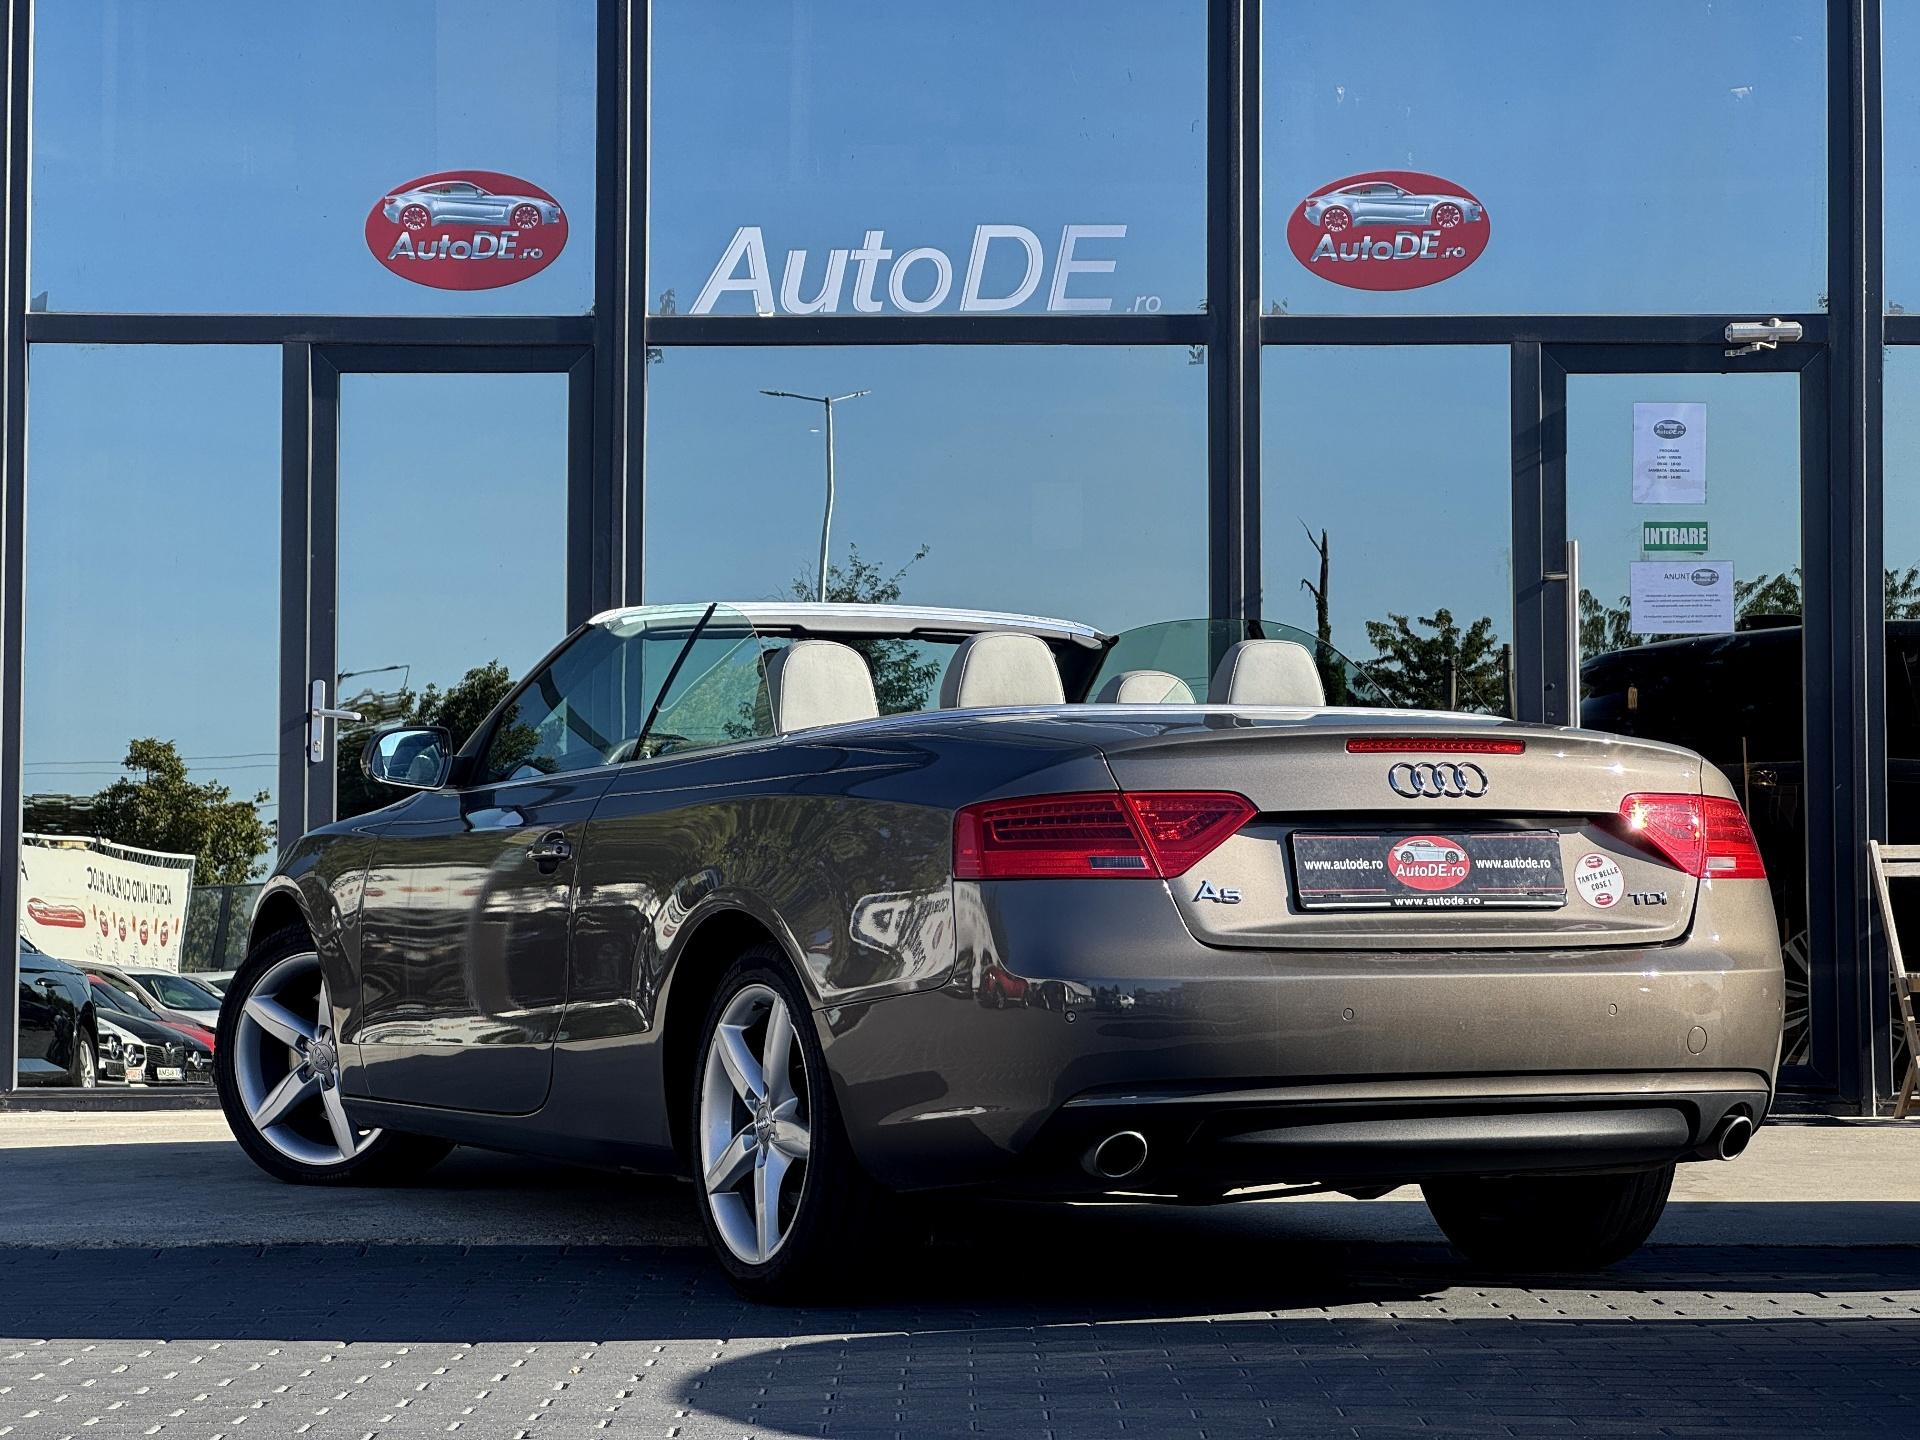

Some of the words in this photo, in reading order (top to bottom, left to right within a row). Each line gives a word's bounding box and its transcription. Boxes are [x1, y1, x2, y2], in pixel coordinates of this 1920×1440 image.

[1644, 527, 1707, 545] INTRARE
[1304, 858, 1384, 870] www.autode.ro
[1475, 857, 1551, 869] www.autode.ro
[1395, 864, 1466, 876] AutoDE.ro
[1578, 872, 1598, 884] TANTE
[1598, 867, 1619, 878] BELLE
[1192, 880, 1242, 905] A5
[1627, 891, 1667, 905] TDI
[1394, 896, 1481, 906] www.autode.ro
